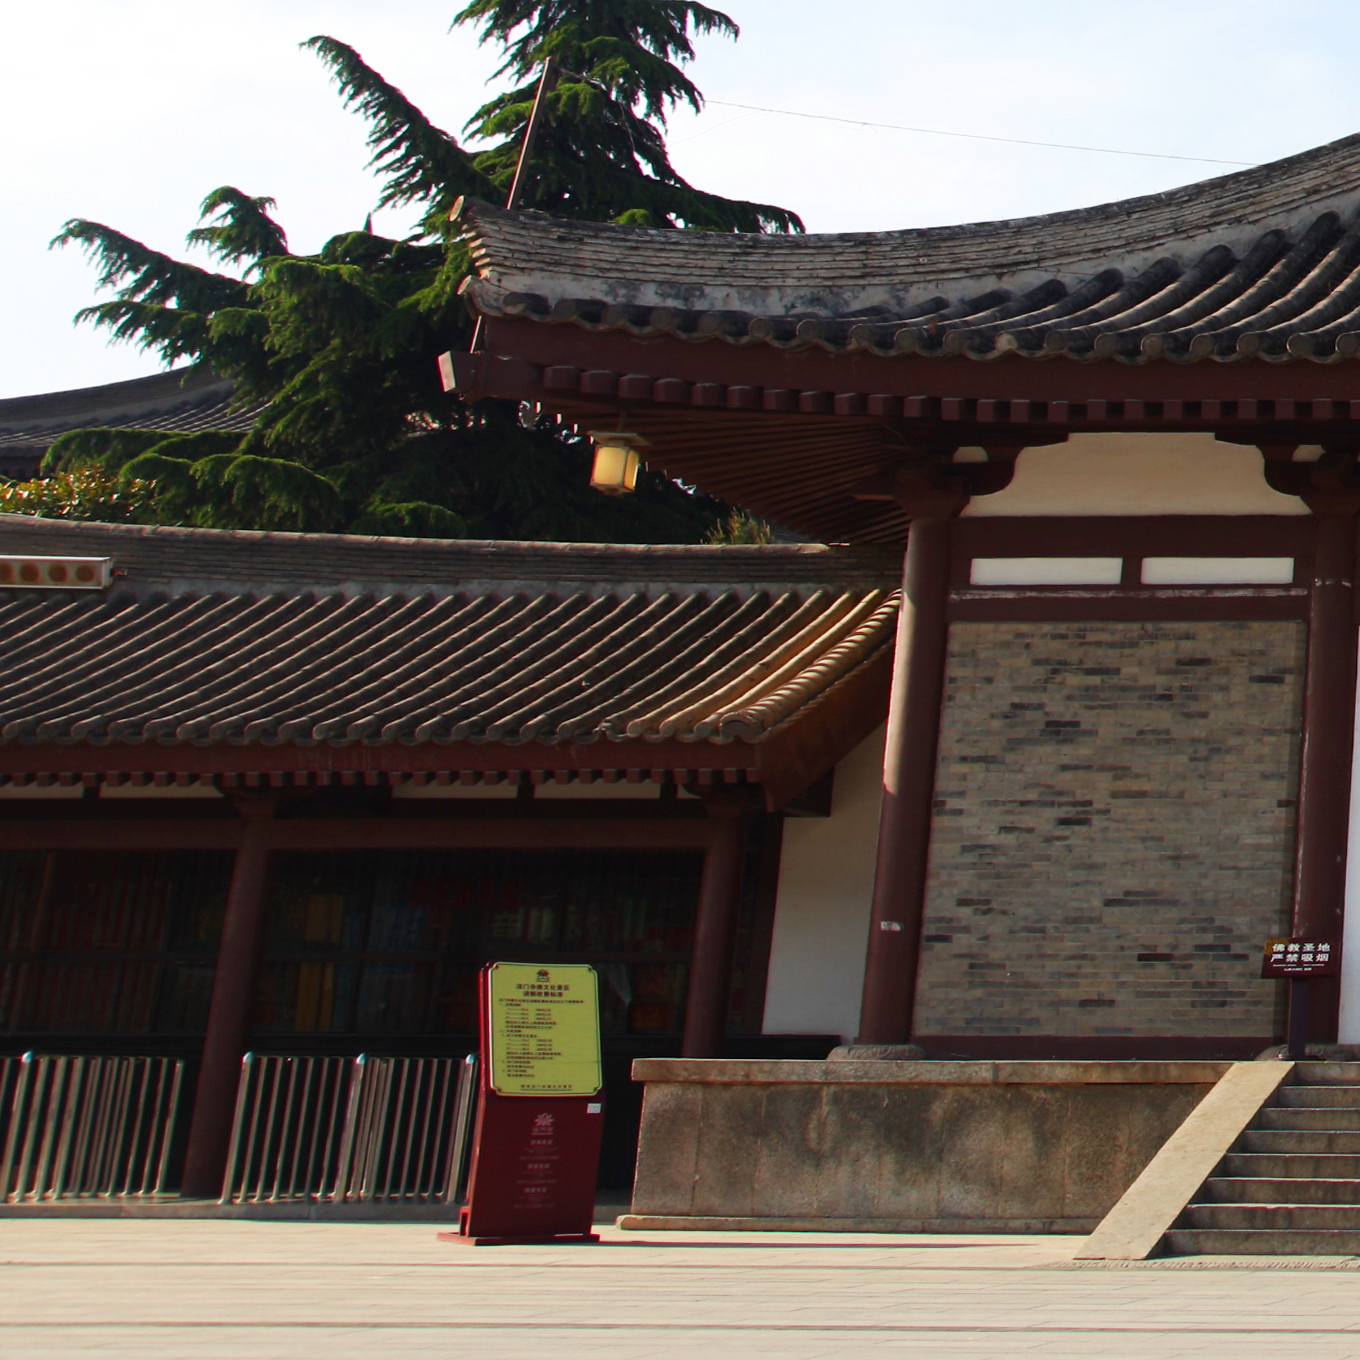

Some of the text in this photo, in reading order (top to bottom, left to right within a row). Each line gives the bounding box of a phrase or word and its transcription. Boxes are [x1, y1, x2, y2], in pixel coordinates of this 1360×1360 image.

[1272, 943, 1330, 952] 佛教圣地
[1270, 953, 1329, 962] 严禁吸烟
